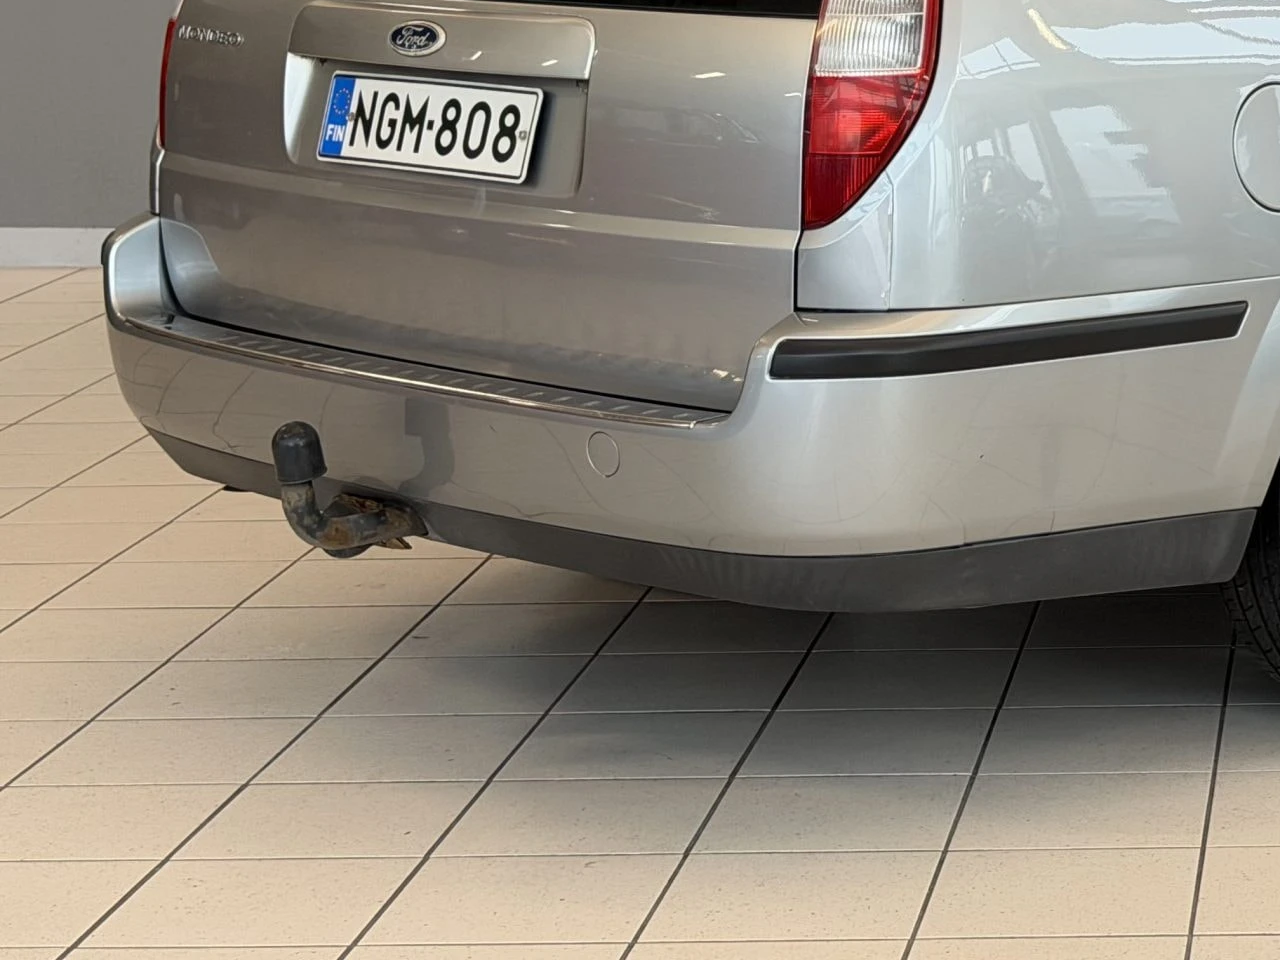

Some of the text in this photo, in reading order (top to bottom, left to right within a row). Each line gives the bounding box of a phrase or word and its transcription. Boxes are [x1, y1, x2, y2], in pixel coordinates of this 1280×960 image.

[396, 26, 430, 48] Ford
[326, 123, 346, 142] FIN
[349, 90, 521, 163] NGM-808
